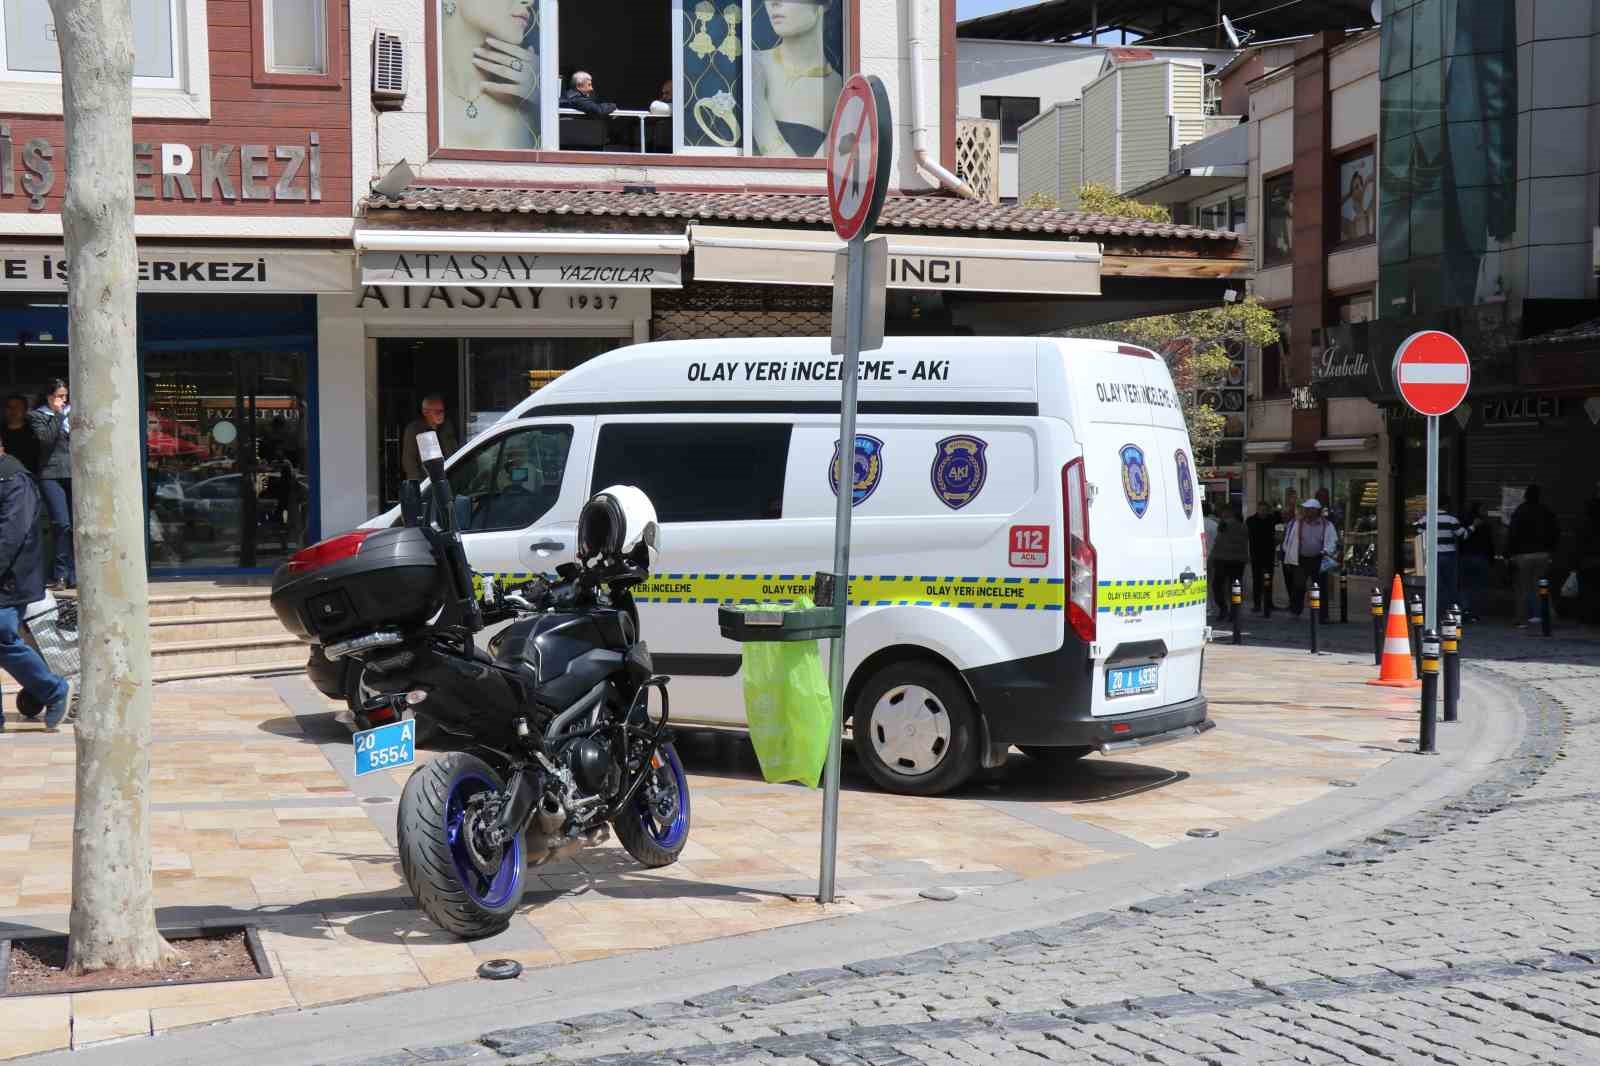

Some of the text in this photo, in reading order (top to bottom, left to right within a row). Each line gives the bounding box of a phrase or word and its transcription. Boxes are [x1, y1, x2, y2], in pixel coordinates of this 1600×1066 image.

[133, 131, 322, 201] ERKEZİ
[138, 258, 267, 282] ERKEZİ
[388, 253, 654, 283] ATASAY YAZICILAR
[569, 295, 620, 311] 1937
[687, 362, 739, 381] OLAY
[1096, 383, 1121, 402] OLAY
[1015, 530, 1043, 550] 112
[762, 585, 785, 594] OLAY
[926, 585, 951, 595] OLAY
[357, 724, 412, 752] 20 A
[369, 745, 409, 767] 5554
